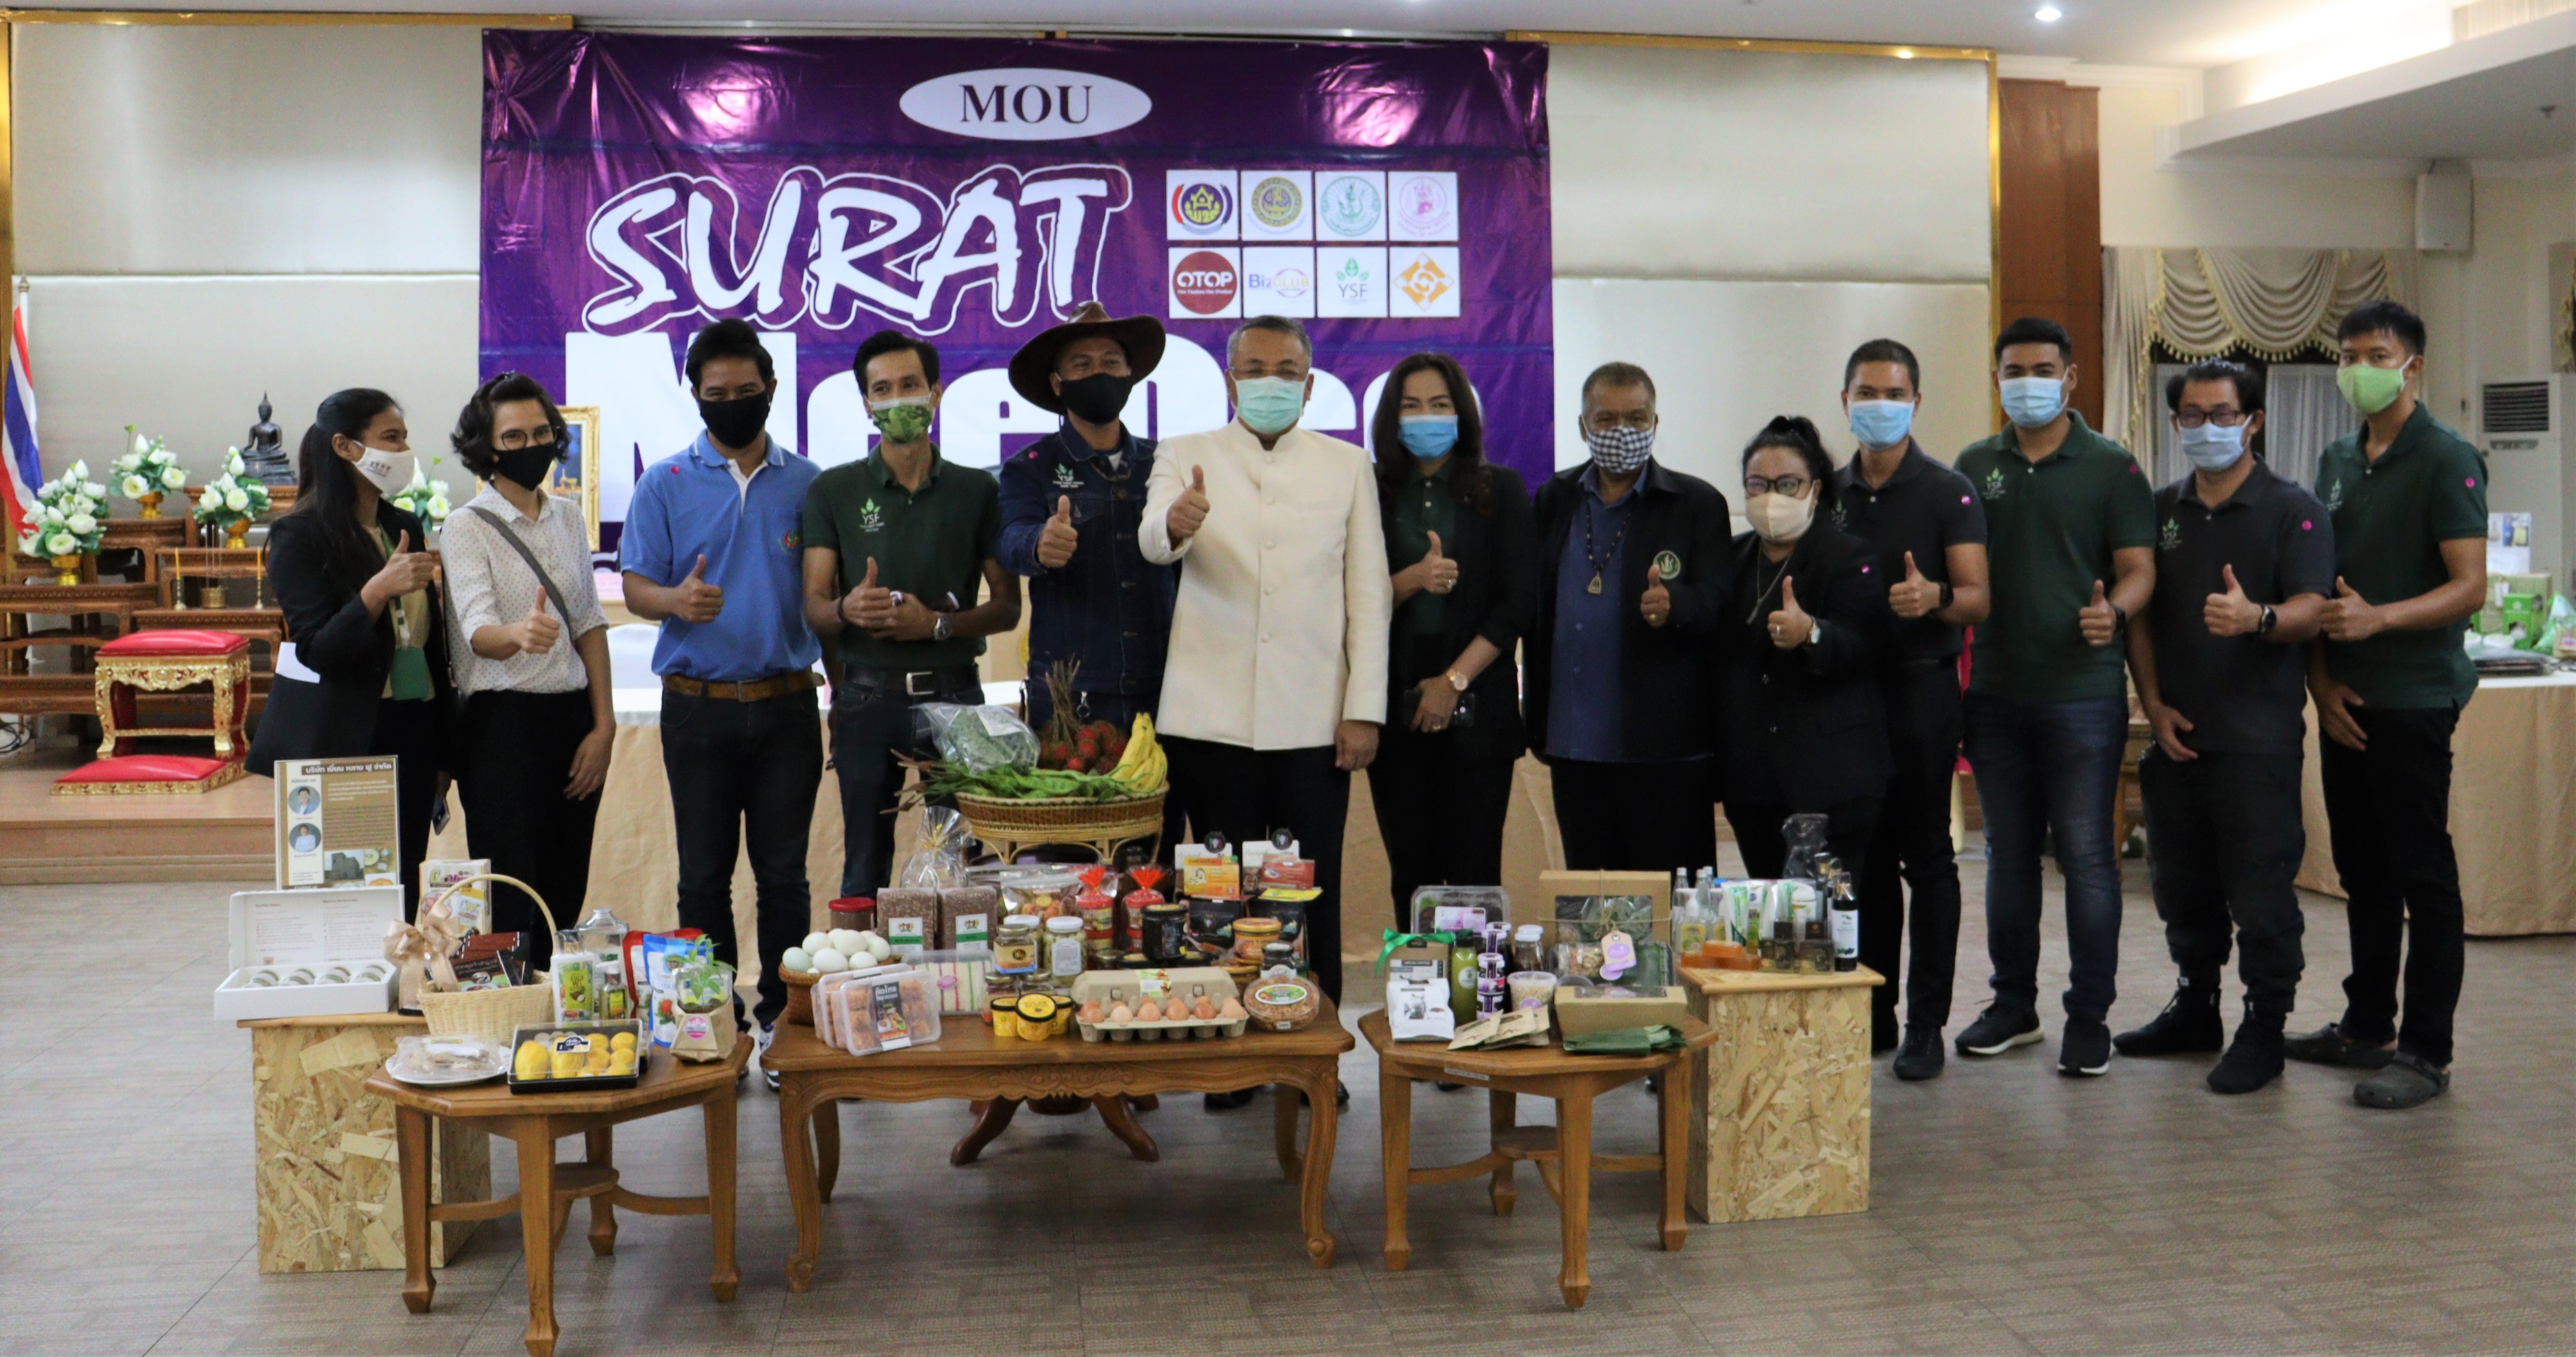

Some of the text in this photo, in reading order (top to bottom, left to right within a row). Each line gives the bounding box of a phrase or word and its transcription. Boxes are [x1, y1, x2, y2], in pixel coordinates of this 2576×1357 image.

[960, 83, 1093, 123] MOU
[585, 168, 1125, 331] SURAT
[1177, 271, 1233, 287] OTOP
[1338, 283, 1368, 298] YSF
[862, 513, 880, 524] YSF
